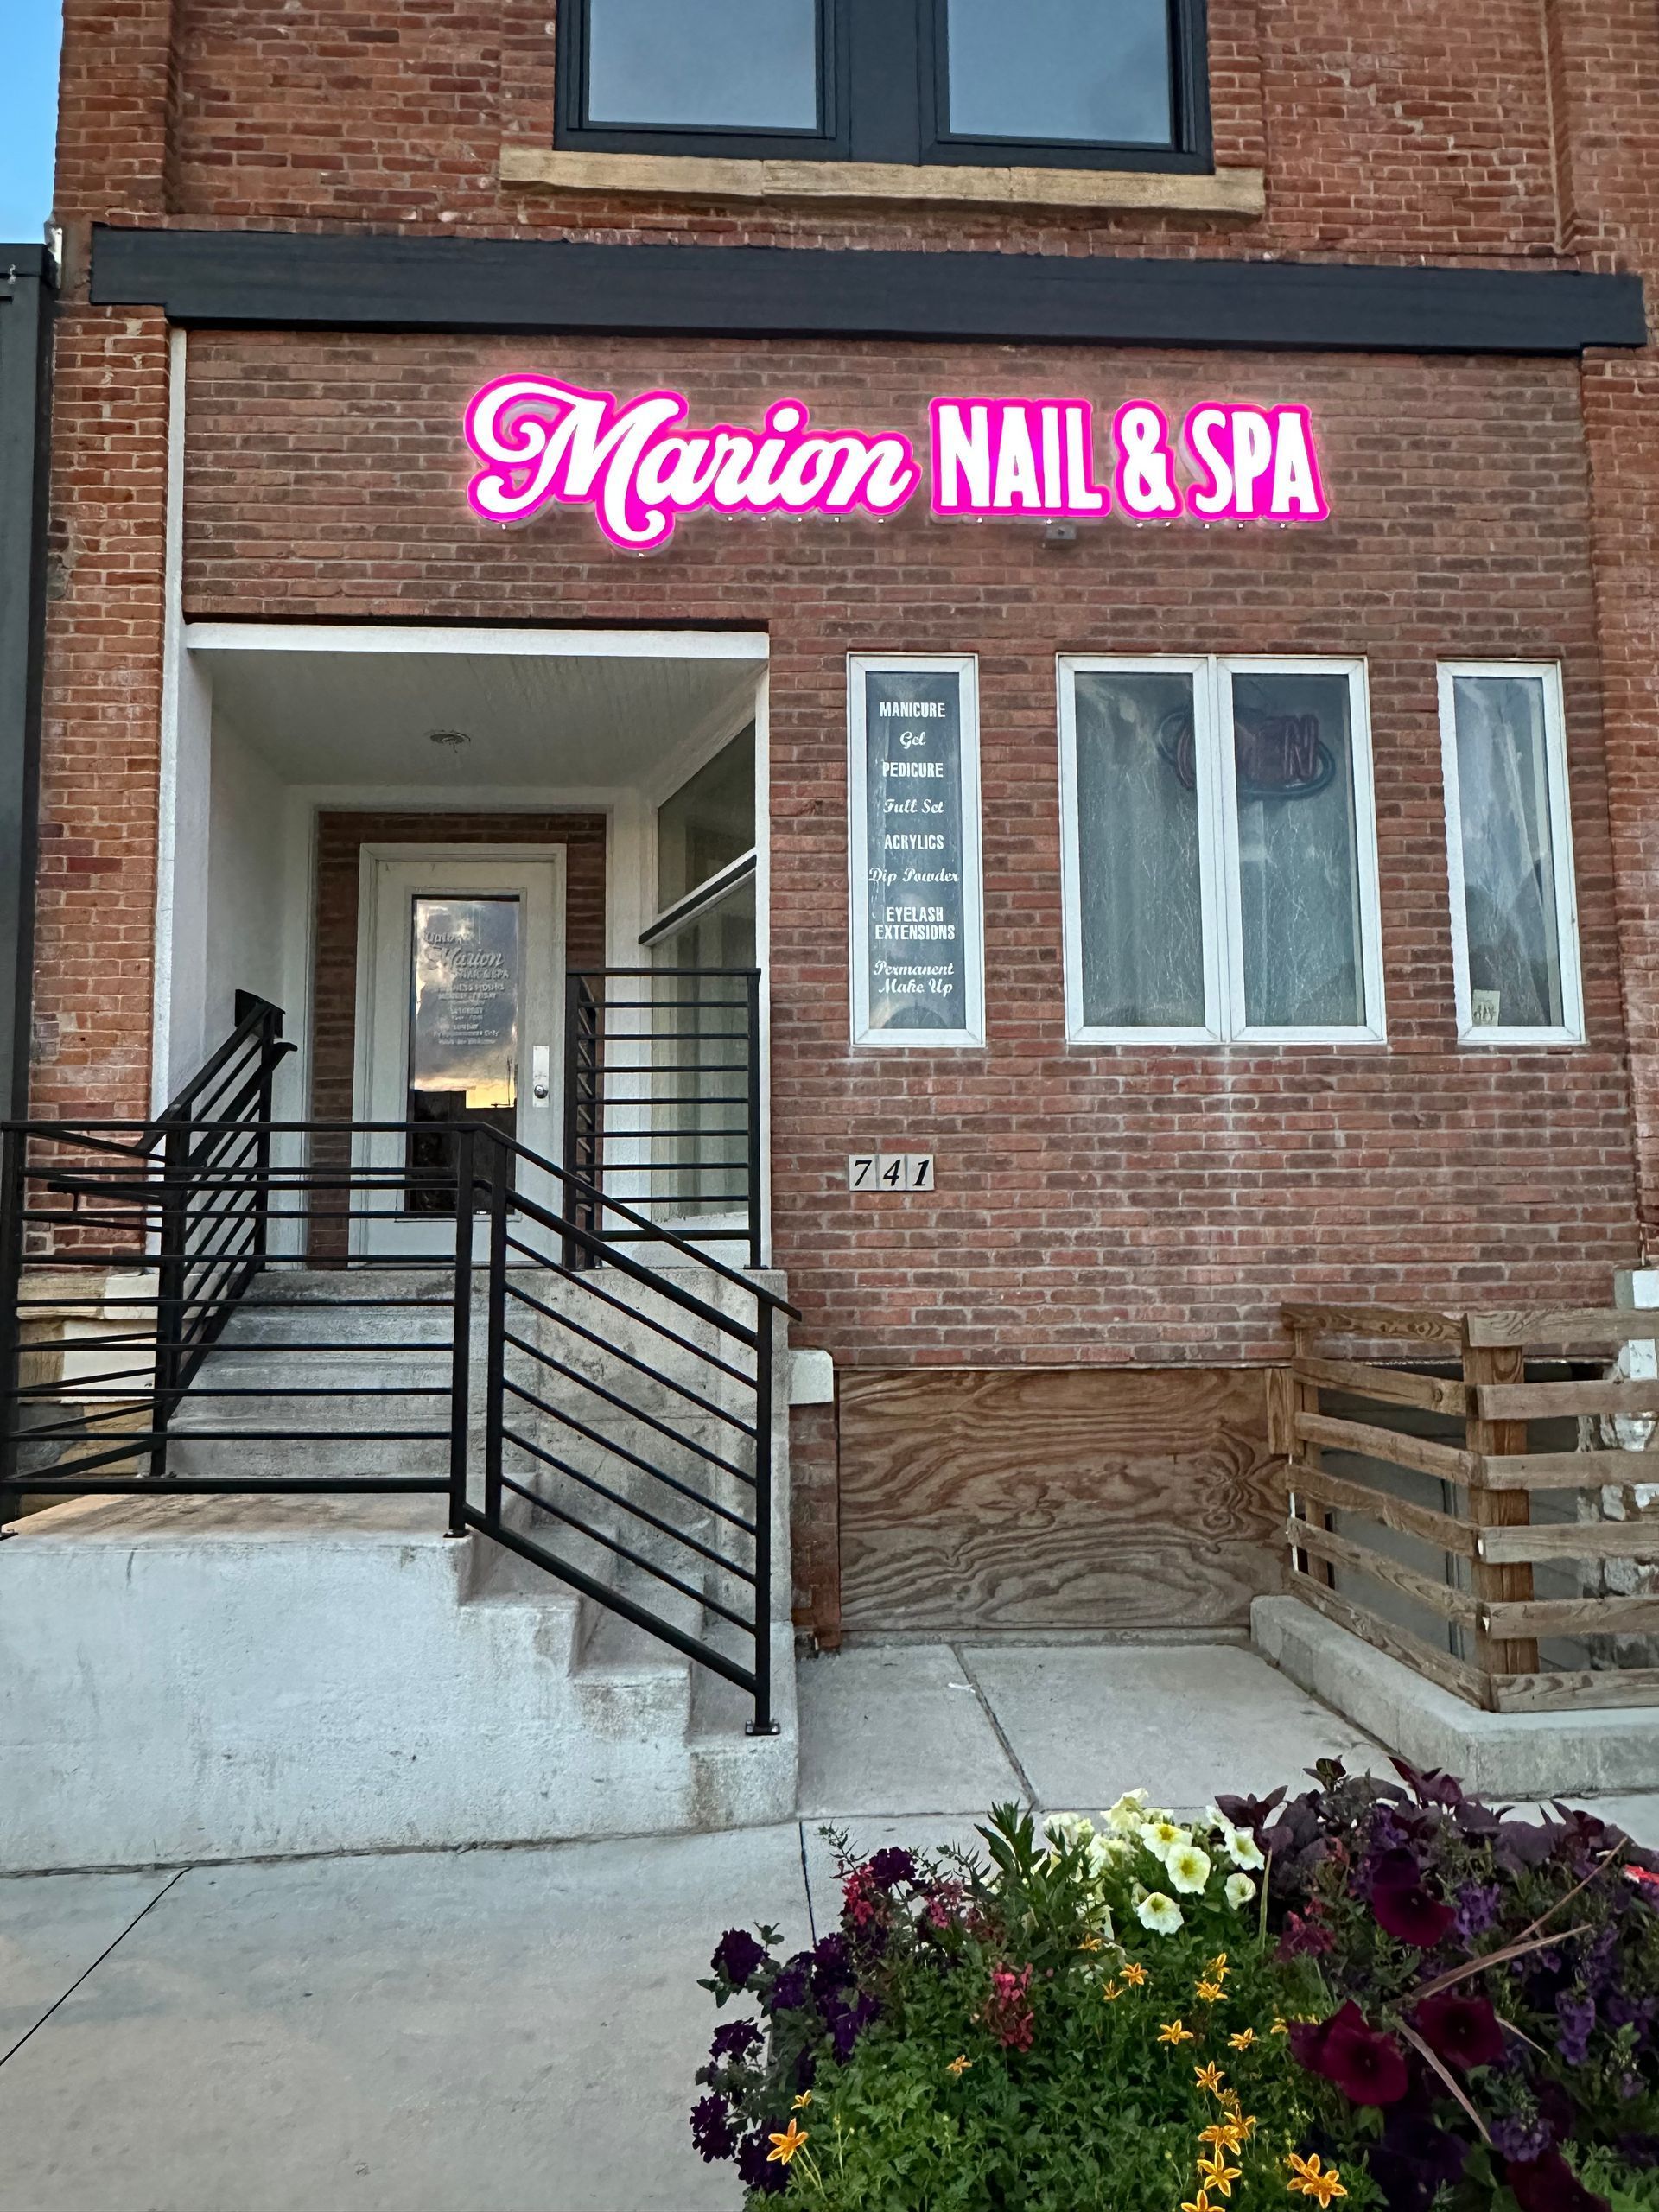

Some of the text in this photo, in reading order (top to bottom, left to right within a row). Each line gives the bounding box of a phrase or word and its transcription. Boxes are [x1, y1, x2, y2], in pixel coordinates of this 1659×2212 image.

[474, 380, 1320, 544] Marion NAIL & SPA
[880, 702, 946, 718] MANICURE
[899, 731, 926, 750] Gel
[882, 762, 944, 778] PEDICURE
[883, 798, 944, 814] Full Set
[884, 834, 944, 849] ACRYLICS
[868, 867, 960, 887] Dip Powder
[886, 906, 944, 922] EYELASH
[874, 924, 956, 940] EXTENSIONS
[873, 960, 955, 976] Permanent
[878, 978, 953, 998] Make Up
[854, 1160, 930, 1187] 741
